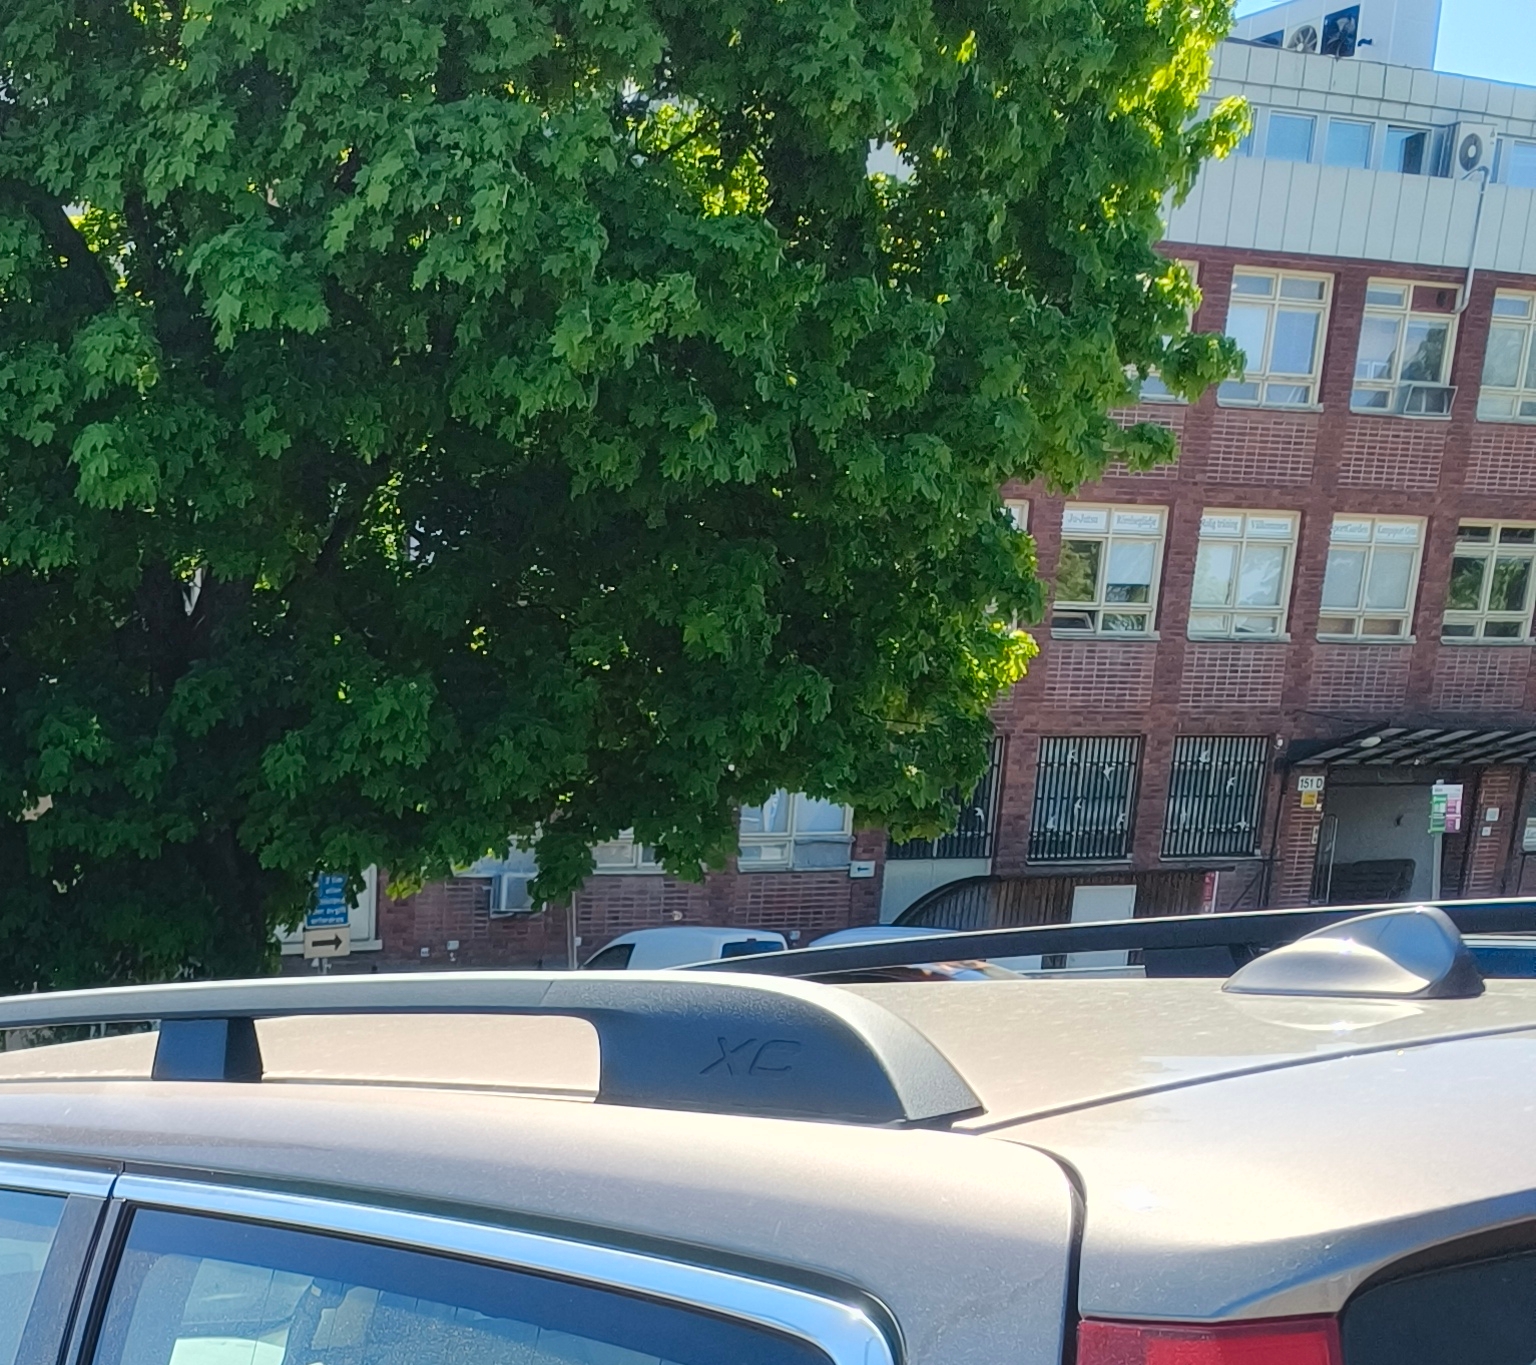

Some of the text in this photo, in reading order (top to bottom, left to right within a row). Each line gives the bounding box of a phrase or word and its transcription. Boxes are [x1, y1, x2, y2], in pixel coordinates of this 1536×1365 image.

[1300, 777, 1324, 789] 151 D
[698, 1035, 802, 1077] XC
